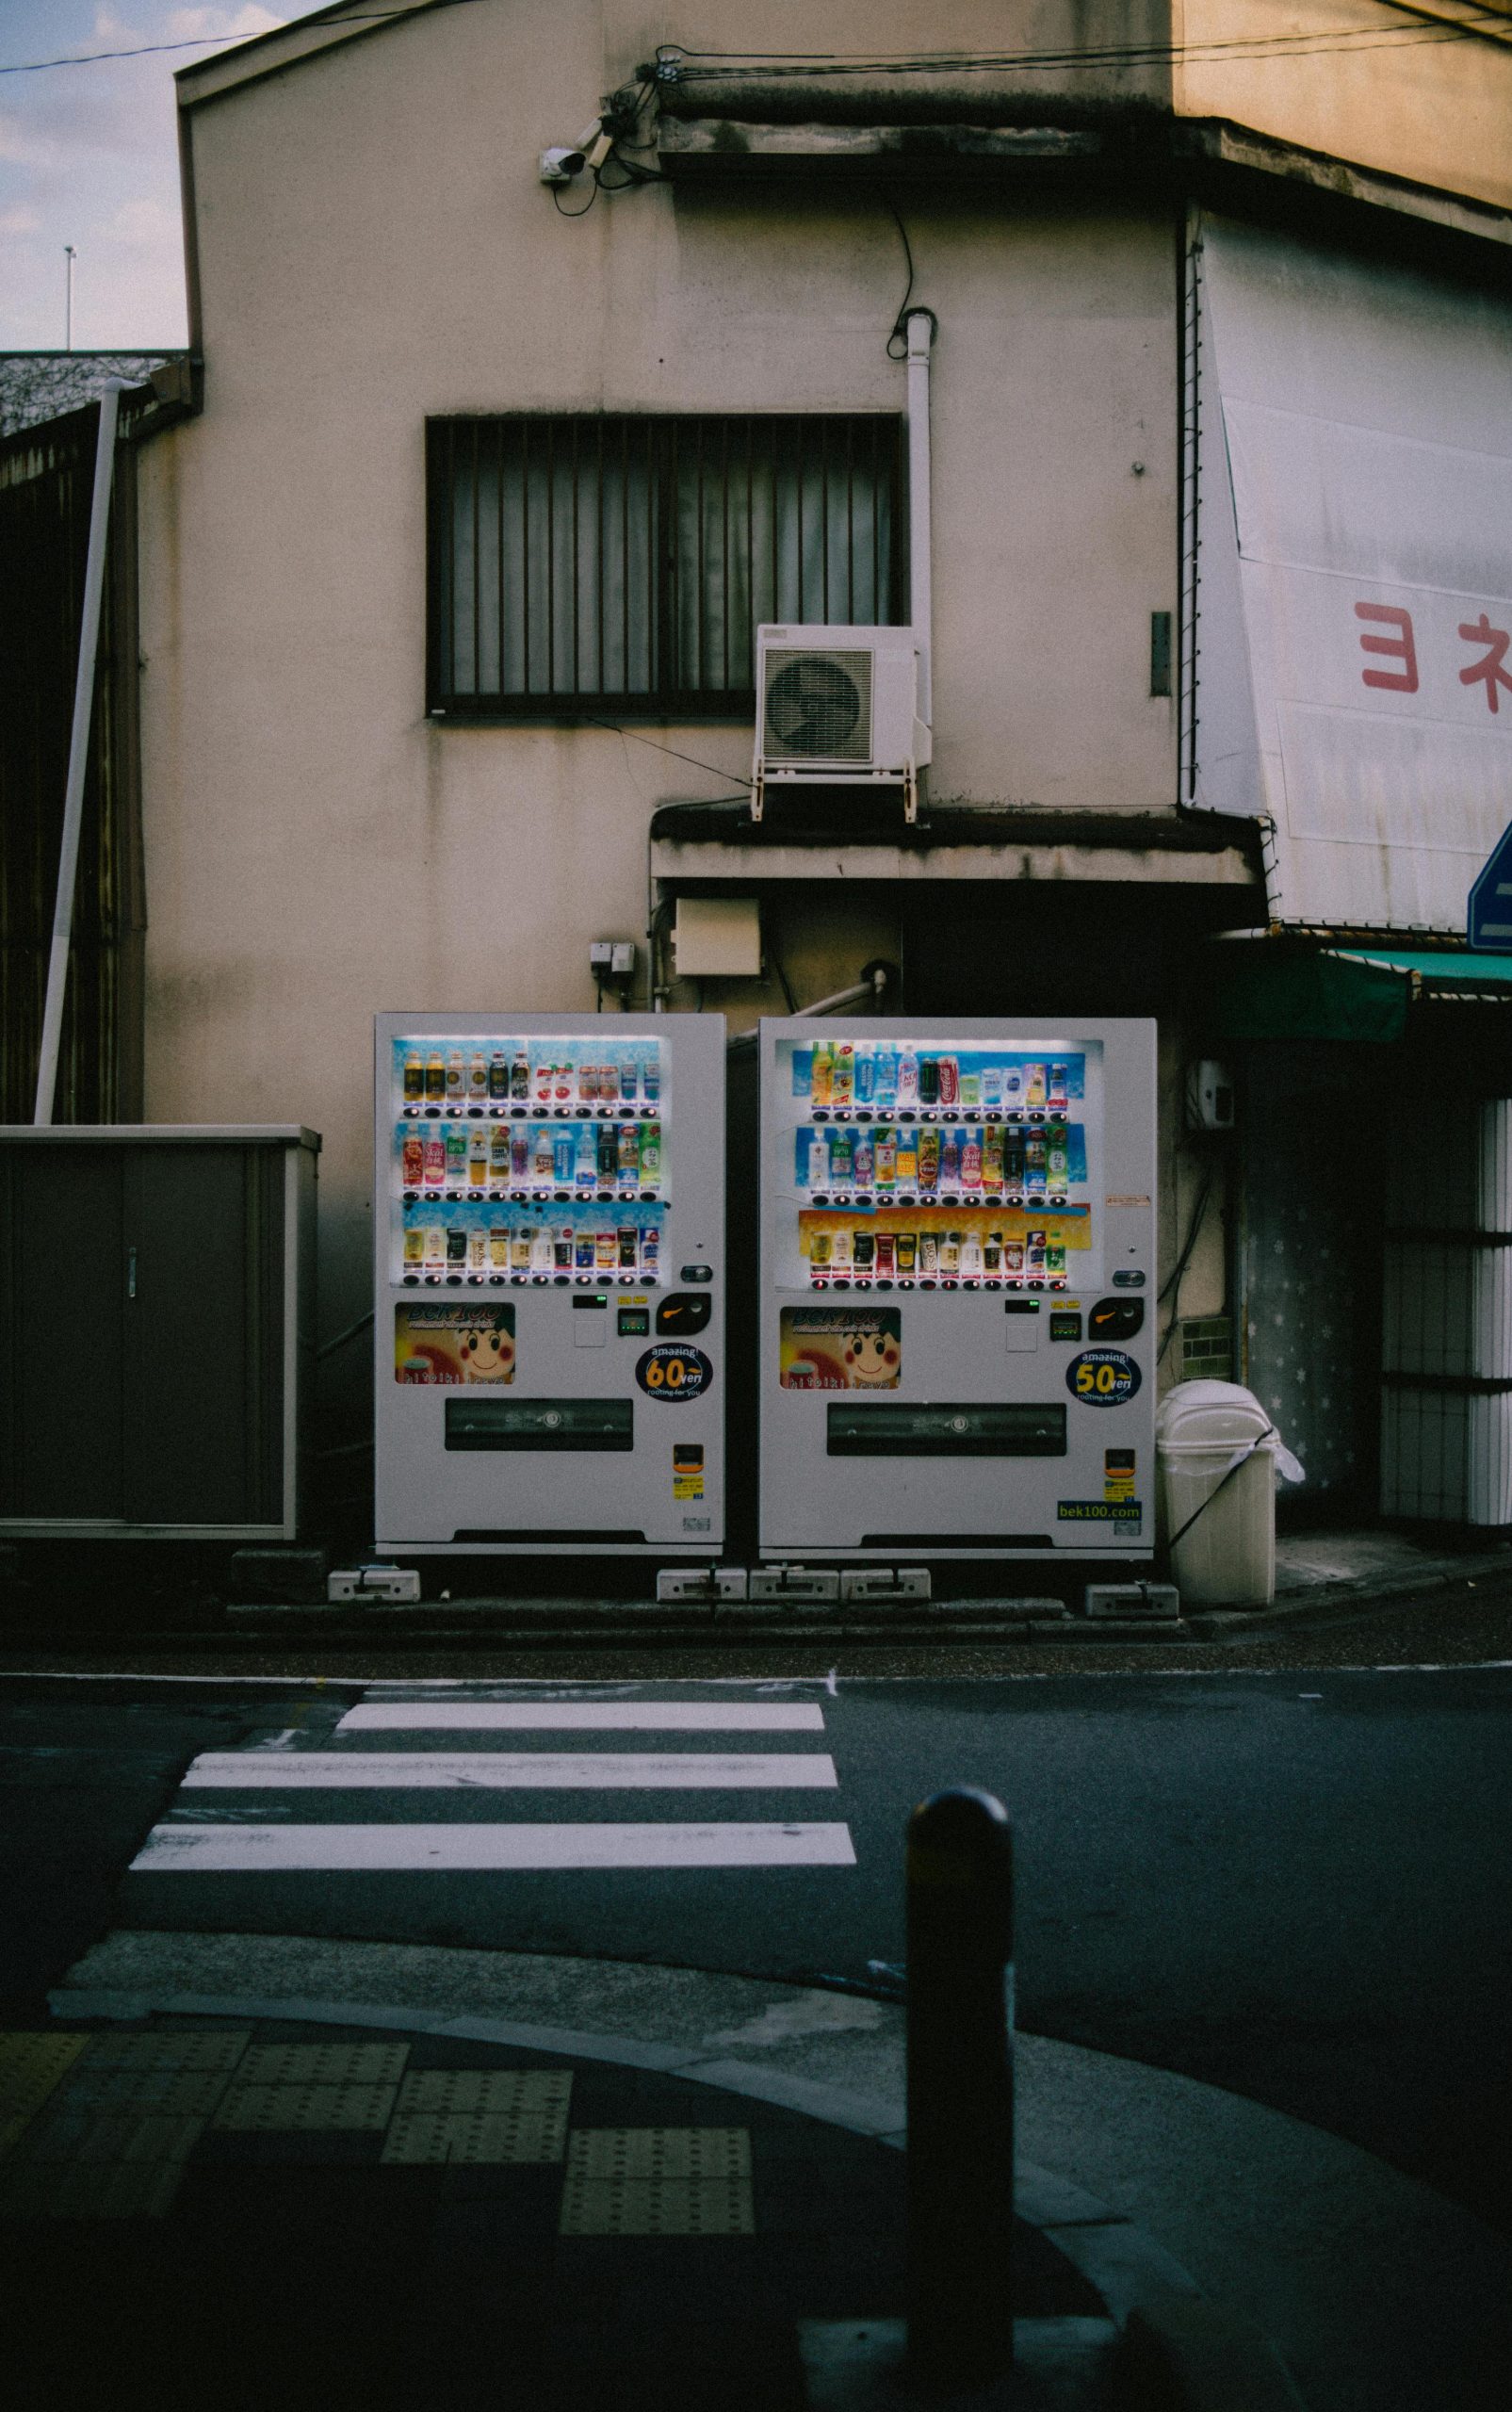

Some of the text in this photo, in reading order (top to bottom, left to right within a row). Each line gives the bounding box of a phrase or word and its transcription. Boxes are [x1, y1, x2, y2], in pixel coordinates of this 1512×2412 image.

[1355, 602, 1512, 714] ヨネ
[926, 1244, 936, 1270] BOSS
[652, 1346, 699, 1359] amazing!
[1082, 1352, 1129, 1363] amazing!
[1060, 1506, 1140, 1517] bek100.com
